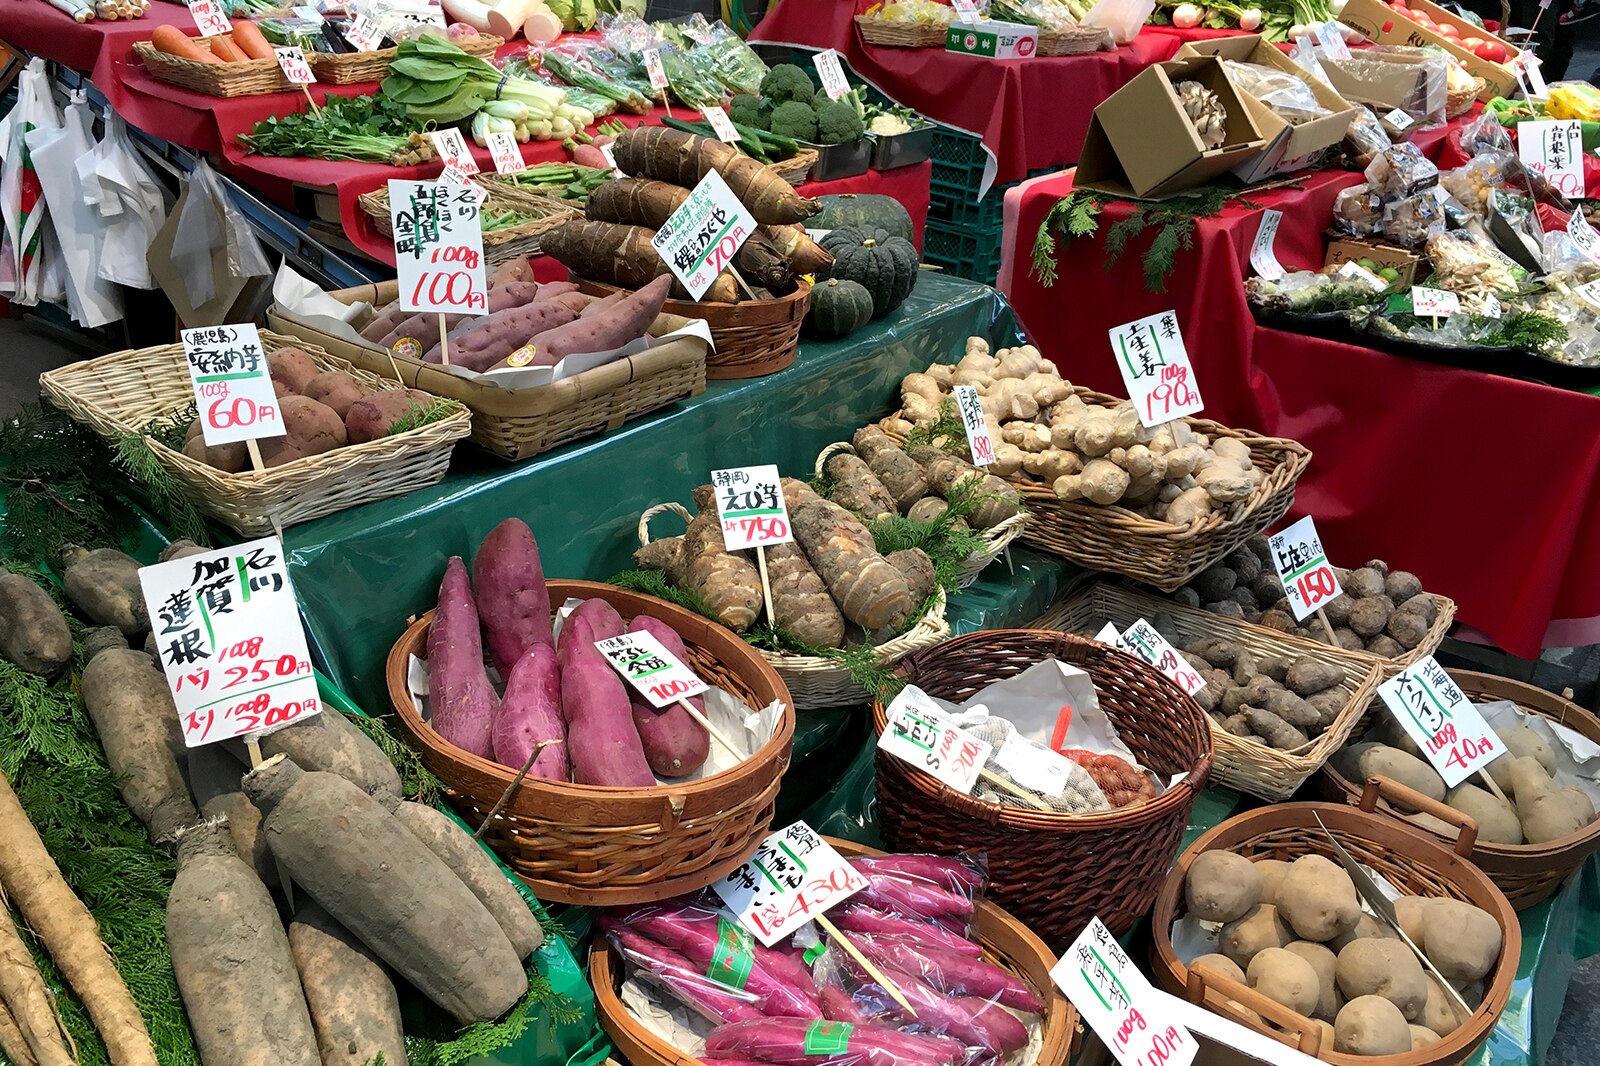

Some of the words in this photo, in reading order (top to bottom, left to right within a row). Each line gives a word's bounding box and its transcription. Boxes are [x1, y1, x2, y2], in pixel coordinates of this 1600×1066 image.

[411, 184, 440, 243] 五郎島
[434, 185, 453, 233] ほくほく
[452, 189, 478, 221] 石川
[395, 210, 426, 259] 金時
[431, 246, 479, 269] 100g
[411, 271, 485, 310] 100円
[185, 327, 238, 346] (鹿児島)
[1160, 315, 1176, 339] 熊本
[189, 344, 262, 374] 安納芋
[1161, 363, 1187, 383] 100g
[198, 380, 231, 398] 100g
[1147, 382, 1199, 421] 190円
[208, 397, 275, 429] 60円
[721, 482, 780, 510] えび芋
[740, 516, 787, 542] 750
[191, 556, 236, 616] 加賀
[240, 547, 283, 592] 石川
[1297, 566, 1335, 608] 150
[157, 588, 212, 667] 蓮根
[218, 636, 264, 663] 100g
[607, 647, 648, 663] なると
[220, 654, 310, 690] 250円
[1423, 658, 1463, 708] 北海道
[224, 693, 271, 719] 100g
[649, 679, 703, 700] 100円
[234, 698, 317, 735] 200円
[1425, 722, 1458, 755] 100g
[1445, 736, 1494, 769] 40円
[787, 867, 863, 917] 430円
[1112, 1007, 1147, 1055] 100g
